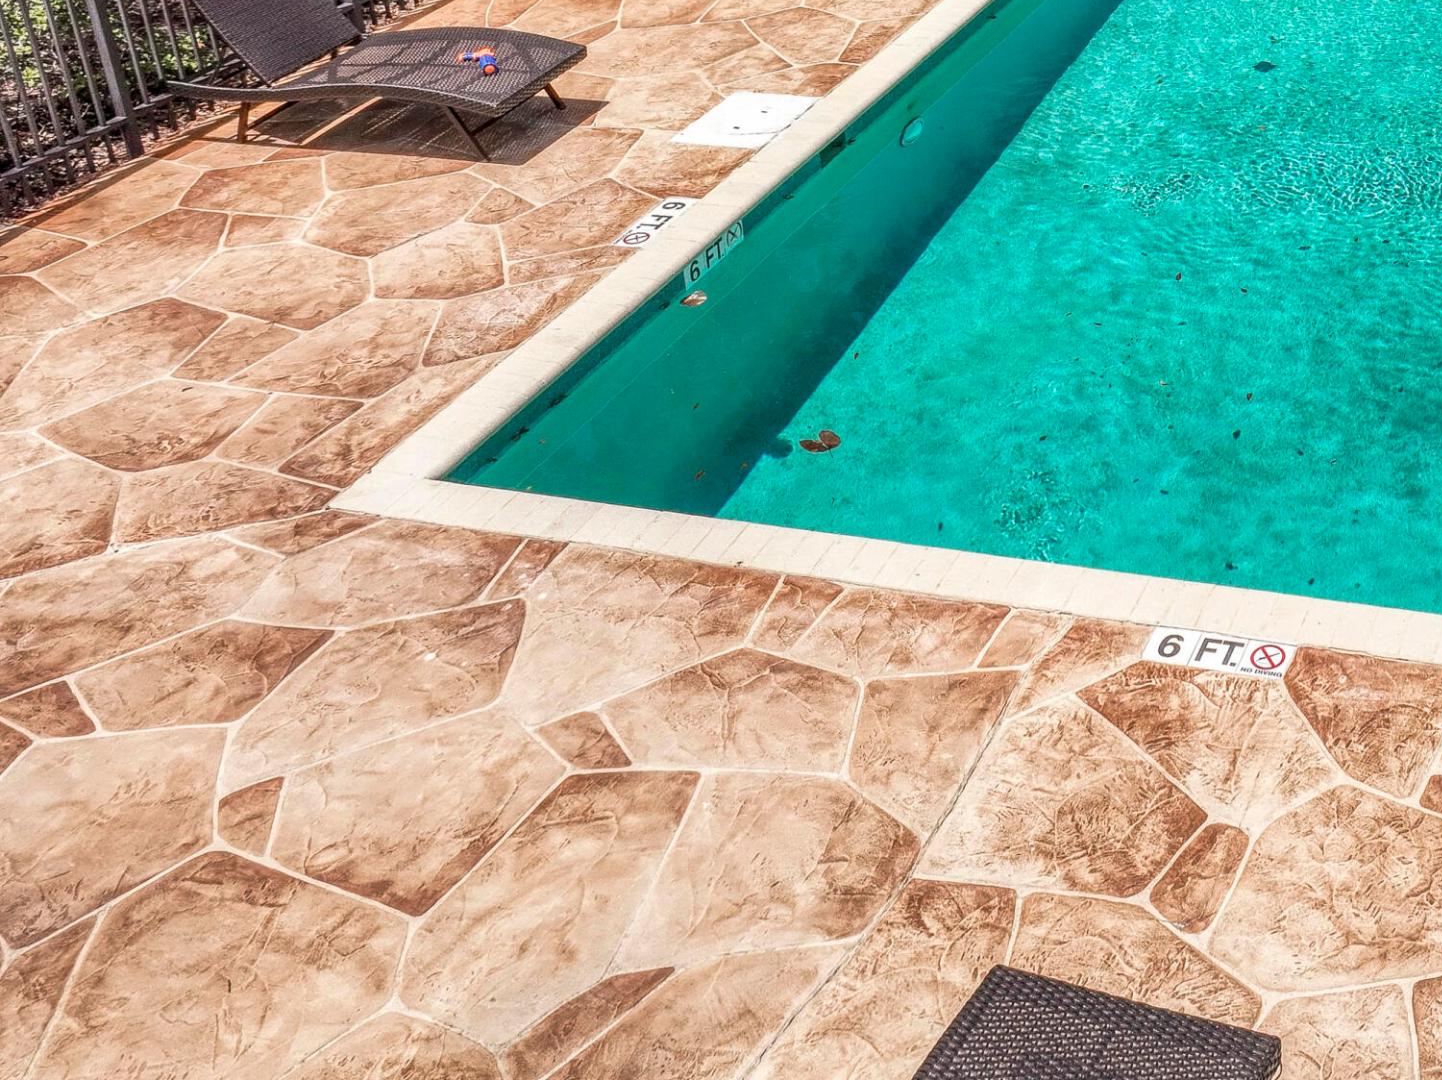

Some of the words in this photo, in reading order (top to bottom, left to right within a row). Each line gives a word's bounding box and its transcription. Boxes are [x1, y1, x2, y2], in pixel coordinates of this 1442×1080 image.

[662, 201, 686, 210] 6
[689, 260, 701, 282] 6
[1157, 634, 1185, 658] 6
[1194, 637, 1245, 667] FT.
[1254, 668, 1283, 678] DIVING
